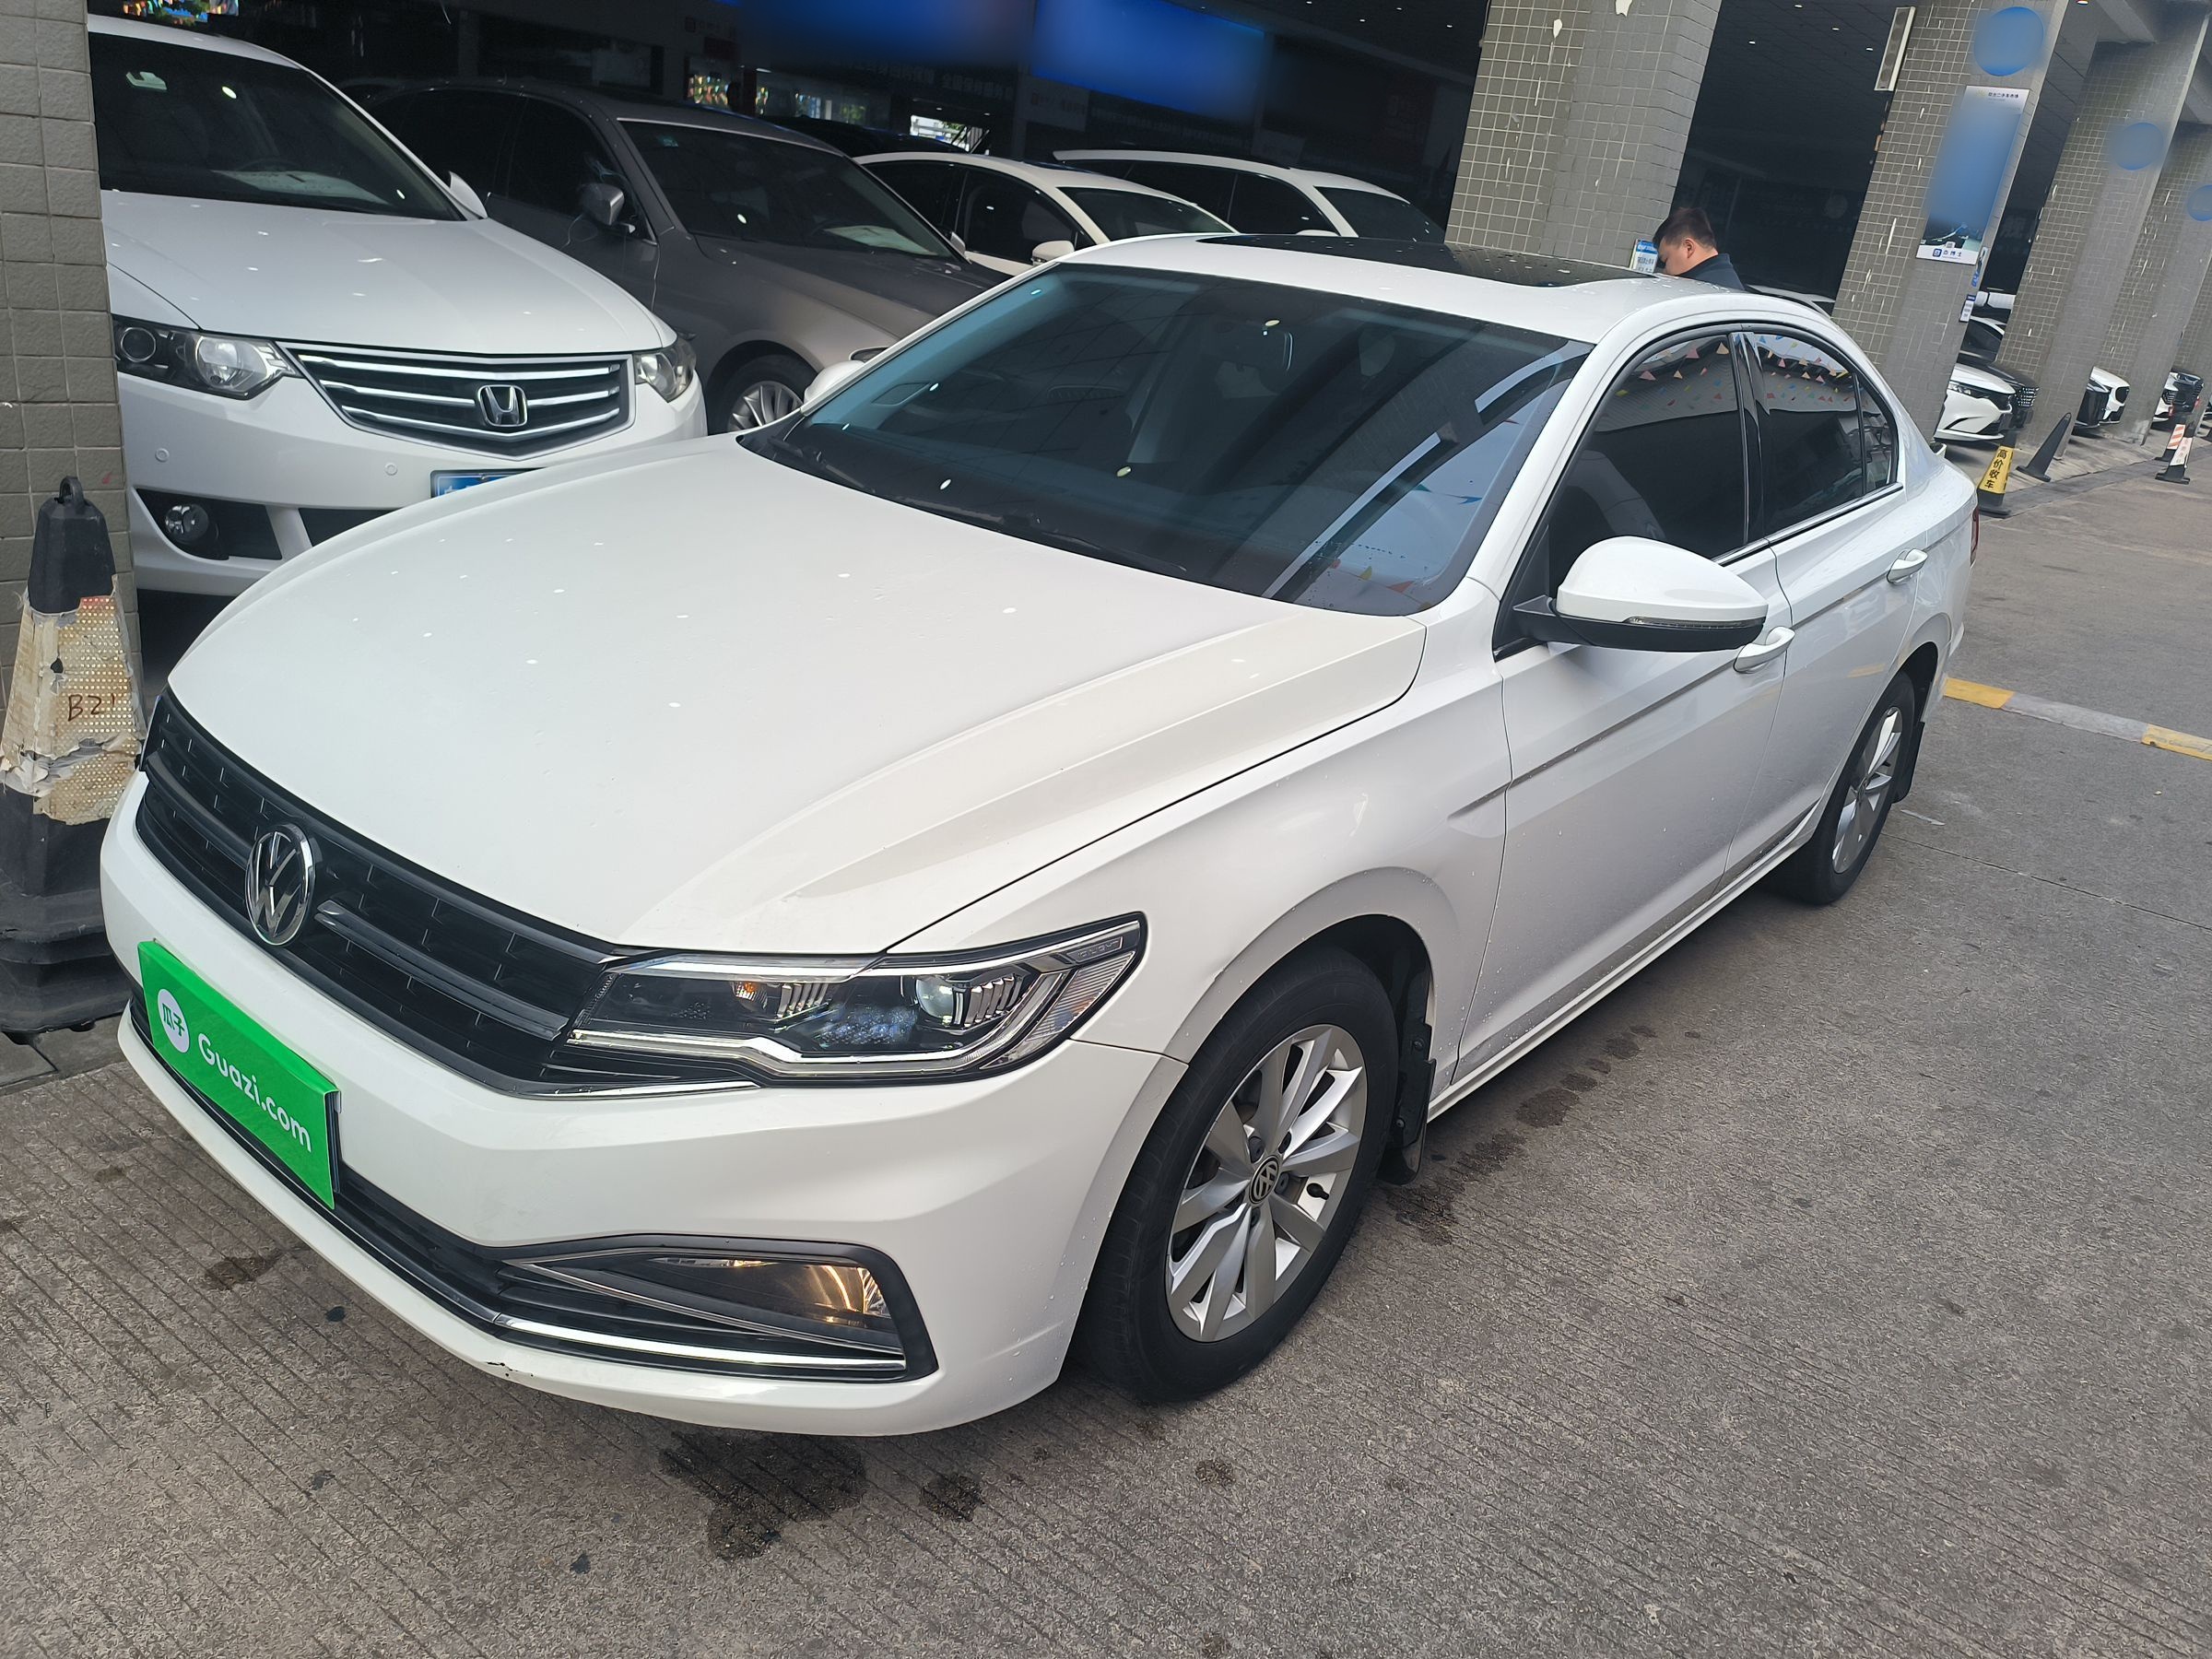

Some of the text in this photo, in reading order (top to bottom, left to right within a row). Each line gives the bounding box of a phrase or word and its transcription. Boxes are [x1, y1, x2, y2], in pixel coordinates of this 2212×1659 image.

[1984, 449, 2008, 488] 高价收车
[161, 1003, 185, 1037] 瓜子
[197, 1032, 312, 1153] Guazi.com
